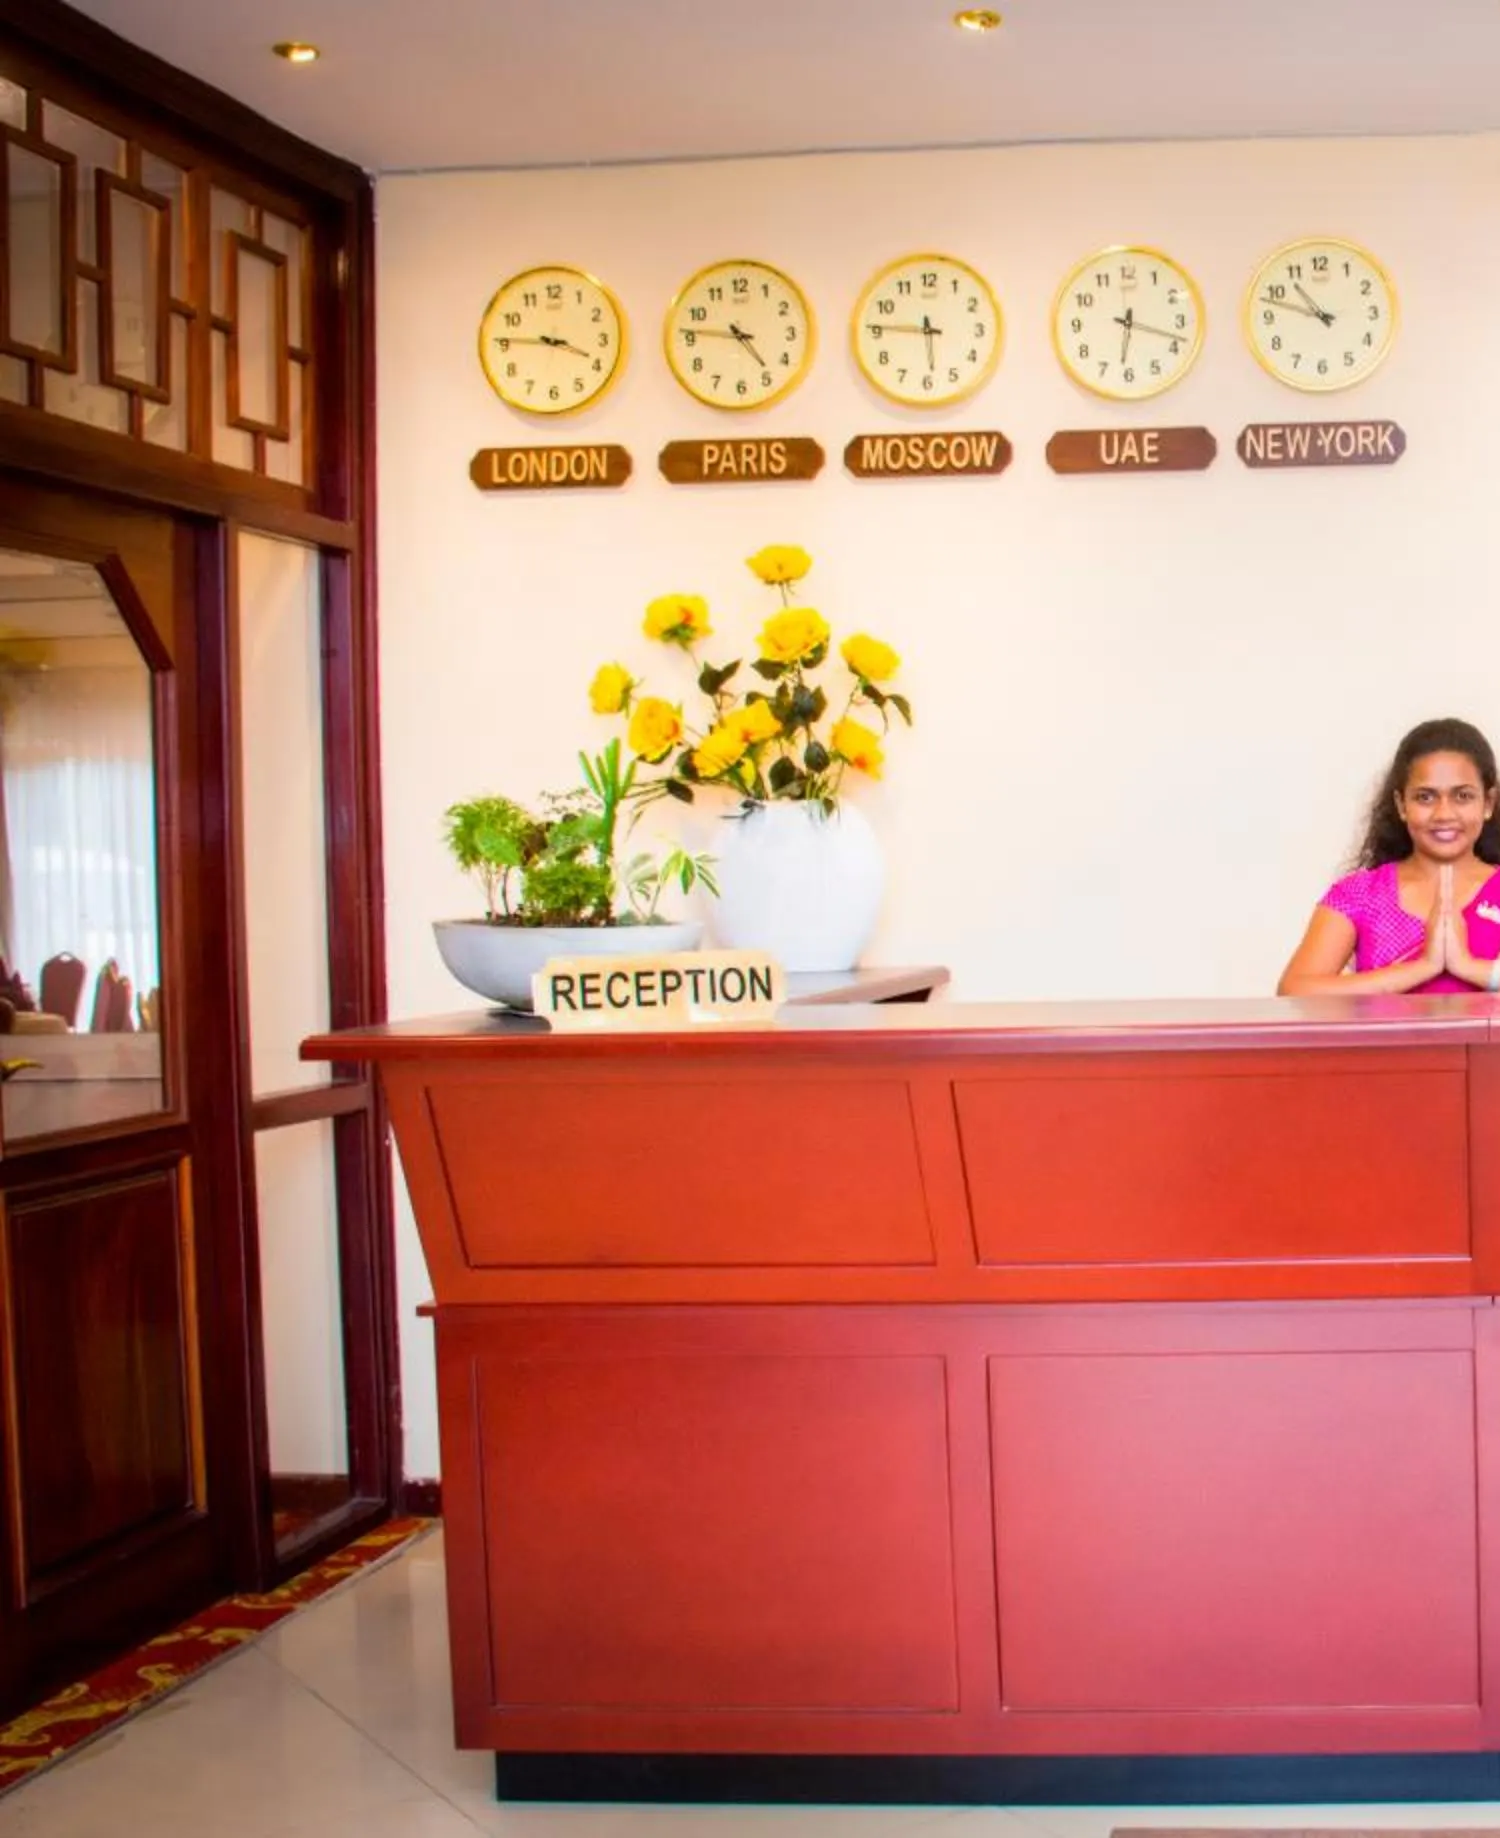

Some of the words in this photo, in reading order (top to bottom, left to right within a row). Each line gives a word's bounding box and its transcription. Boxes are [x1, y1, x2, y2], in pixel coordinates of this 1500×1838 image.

[1312, 256, 1328, 271] 12
[1343, 262, 1349, 277] 1
[1150, 271, 1157, 285] 1
[1287, 265, 1301, 278] 11
[732, 278, 748, 293] 12
[921, 273, 937, 287] 12
[952, 279, 958, 293] 1
[1096, 274, 1109, 287] 11
[546, 284, 562, 299] 12
[708, 288, 722, 301] 11
[762, 284, 768, 298] 1
[897, 281, 911, 294] 11
[1267, 285, 1285, 299] 10
[1360, 280, 1371, 295] 2
[524, 294, 537, 307] 11
[576, 291, 582, 304] 1
[968, 297, 978, 312] 2
[1076, 294, 1093, 307] 10
[779, 301, 789, 315] 2
[877, 300, 894, 314] 10
[1369, 306, 1378, 320] 3
[504, 313, 521, 326] 10
[592, 308, 601, 322] 2
[690, 308, 706, 321] 10
[1175, 314, 1185, 329] 3
[1263, 311, 1274, 325] 9
[872, 326, 882, 338] 9
[975, 323, 984, 337] 3
[1072, 318, 1081, 332] 9
[599, 333, 608, 347] 3
[685, 331, 695, 346] 9
[786, 327, 795, 341] 3
[1363, 332, 1371, 347] 4
[500, 338, 509, 352] 9
[1169, 340, 1179, 355] 4
[1272, 336, 1281, 350] 8
[879, 351, 888, 365] 8
[967, 349, 976, 362] 4
[1079, 344, 1088, 358] 8
[592, 359, 601, 372] 4
[693, 358, 702, 371] 8
[780, 353, 789, 366] 4
[1291, 354, 1301, 368] 7
[1344, 352, 1354, 366] 5
[507, 363, 517, 376] 8
[1099, 362, 1108, 376] 7
[1151, 360, 1160, 374] 5
[1317, 360, 1328, 374] 6
[762, 372, 772, 386] 5
[898, 369, 907, 382] 7
[949, 368, 958, 382] 5
[1124, 368, 1134, 382] 6
[526, 380, 534, 394] 7
[574, 378, 584, 392] 5
[711, 376, 720, 389] 7
[737, 381, 746, 394] 6
[922, 376, 933, 390] 6
[550, 386, 559, 400] 6
[1101, 432, 1160, 464] UAE
[1245, 427, 1312, 459] NEW
[1318, 423, 1395, 456] YORK
[702, 442, 787, 475] PARIS
[861, 435, 998, 469] MOSCOW
[491, 448, 608, 483] LONDON
[551, 965, 773, 1011] RECEPTION
